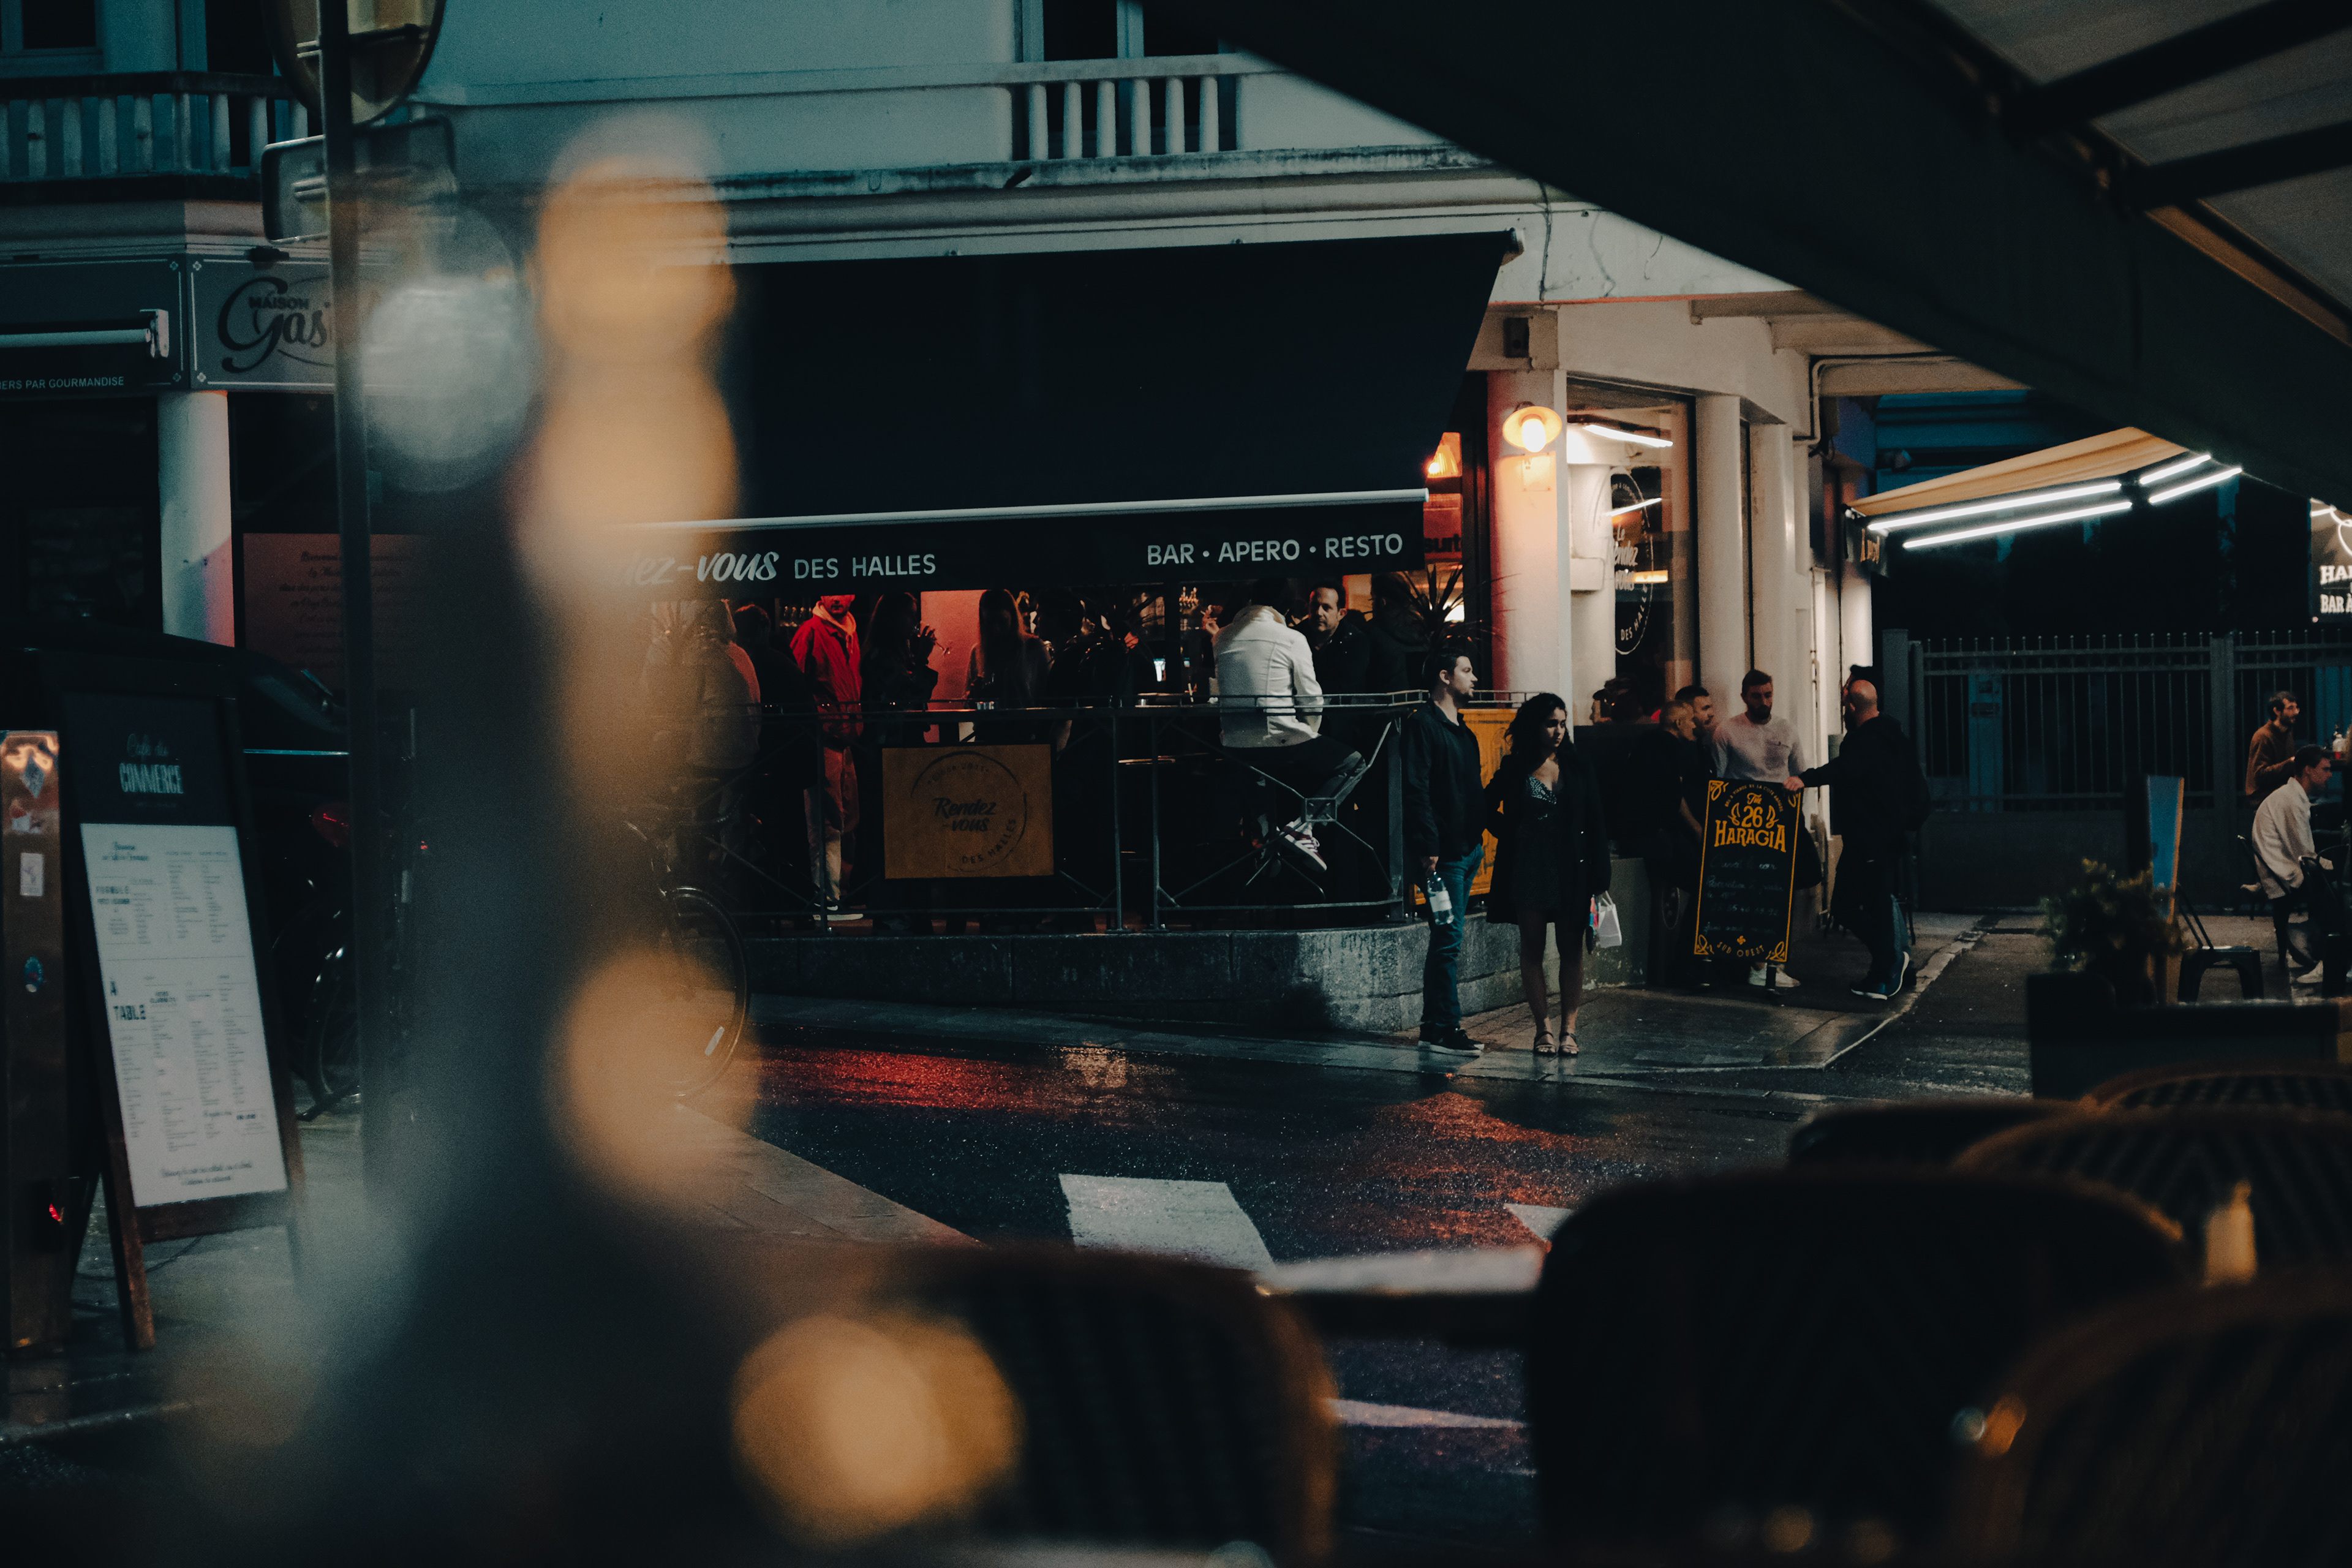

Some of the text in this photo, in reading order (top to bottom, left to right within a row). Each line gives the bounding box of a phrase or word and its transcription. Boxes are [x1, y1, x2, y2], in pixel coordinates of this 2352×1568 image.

[249, 296, 309, 310] MAISON
[217, 277, 333, 374] Gas
[25, 379, 46, 389] PAR
[48, 376, 124, 388] GOURMANDISE
[1147, 543, 1194, 565] BAR
[1218, 538, 1300, 563] APERO
[1325, 533, 1403, 559] RESTO
[794, 557, 839, 579] DES
[852, 552, 936, 576] HALLES
[2320, 594, 2345, 613] BAR
[1620, 626, 1633, 641] DES
[119, 762, 184, 794] COMMERCE
[933, 797, 997, 819] Rendez
[1741, 805, 1763, 828] 26
[962, 819, 1016, 865] DES HALLES
[1714, 820, 1787, 853] HARAGIA
[1716, 941, 1765, 957] SUD OUEST
[113, 1003, 146, 1021] TABLE
